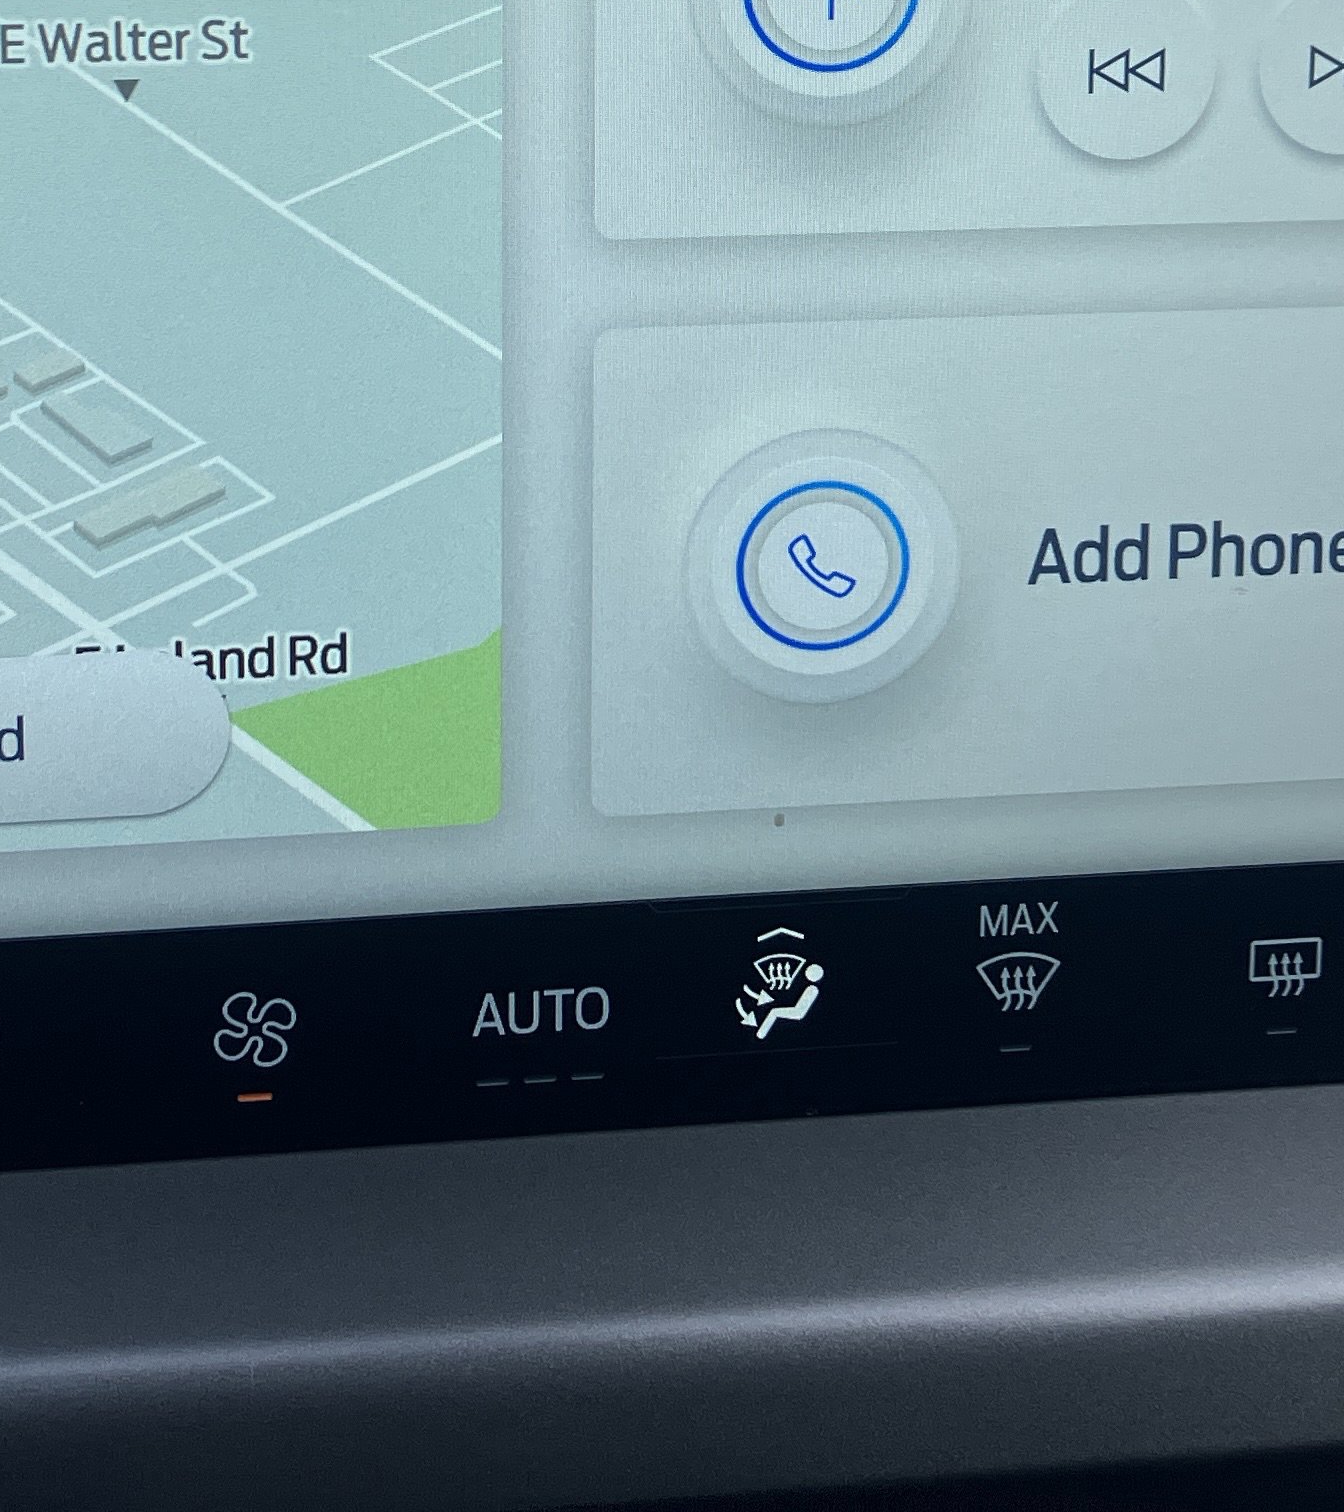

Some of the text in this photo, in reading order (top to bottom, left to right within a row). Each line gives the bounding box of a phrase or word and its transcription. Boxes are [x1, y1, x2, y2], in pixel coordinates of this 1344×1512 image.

[0, 19, 250, 64] E Walter St
[1027, 522, 1150, 585] Add
[288, 631, 348, 677] Rd
[978, 901, 1060, 936] MAX
[472, 986, 611, 1038] AUTO
